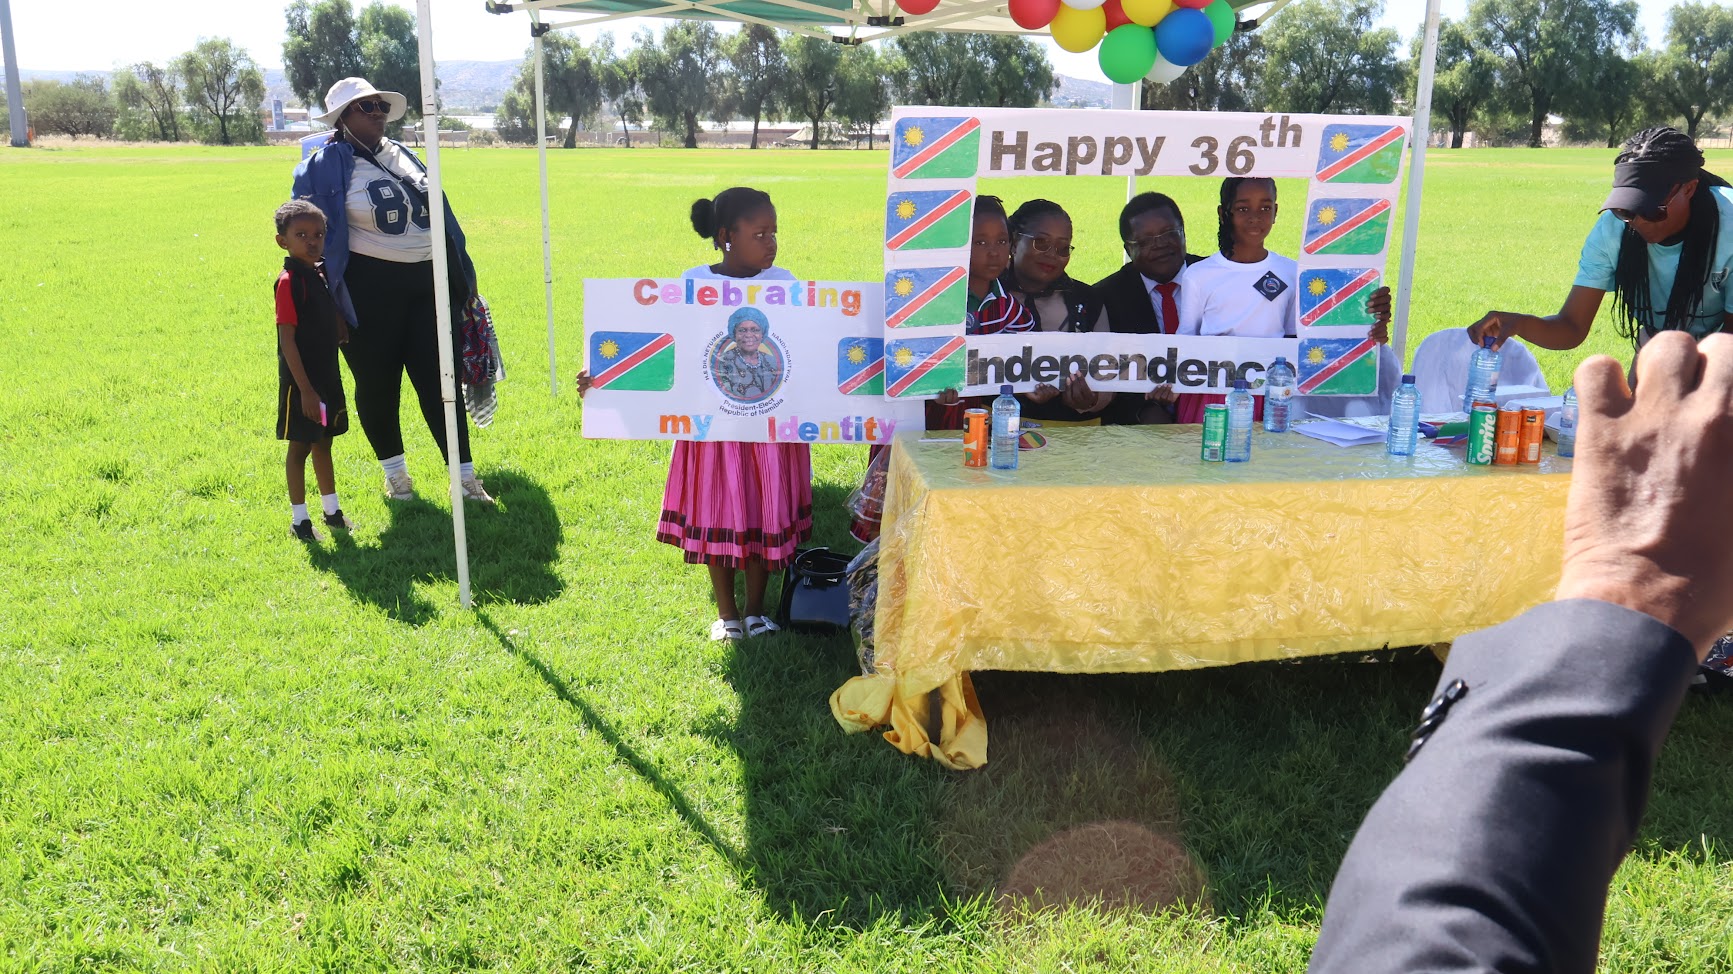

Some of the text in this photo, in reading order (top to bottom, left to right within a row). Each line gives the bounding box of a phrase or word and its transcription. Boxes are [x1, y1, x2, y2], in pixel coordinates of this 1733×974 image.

[990, 115, 1304, 177] Happy 36th
[633, 278, 862, 317] Celebrating
[703, 331, 724, 357] NETUMBO
[719, 405, 749, 417] Republic
[758, 398, 784, 416] Namibia
[723, 397, 775, 411] President-Elect
[659, 414, 898, 443] my Identity
[1477, 413, 1496, 465] Sprite
